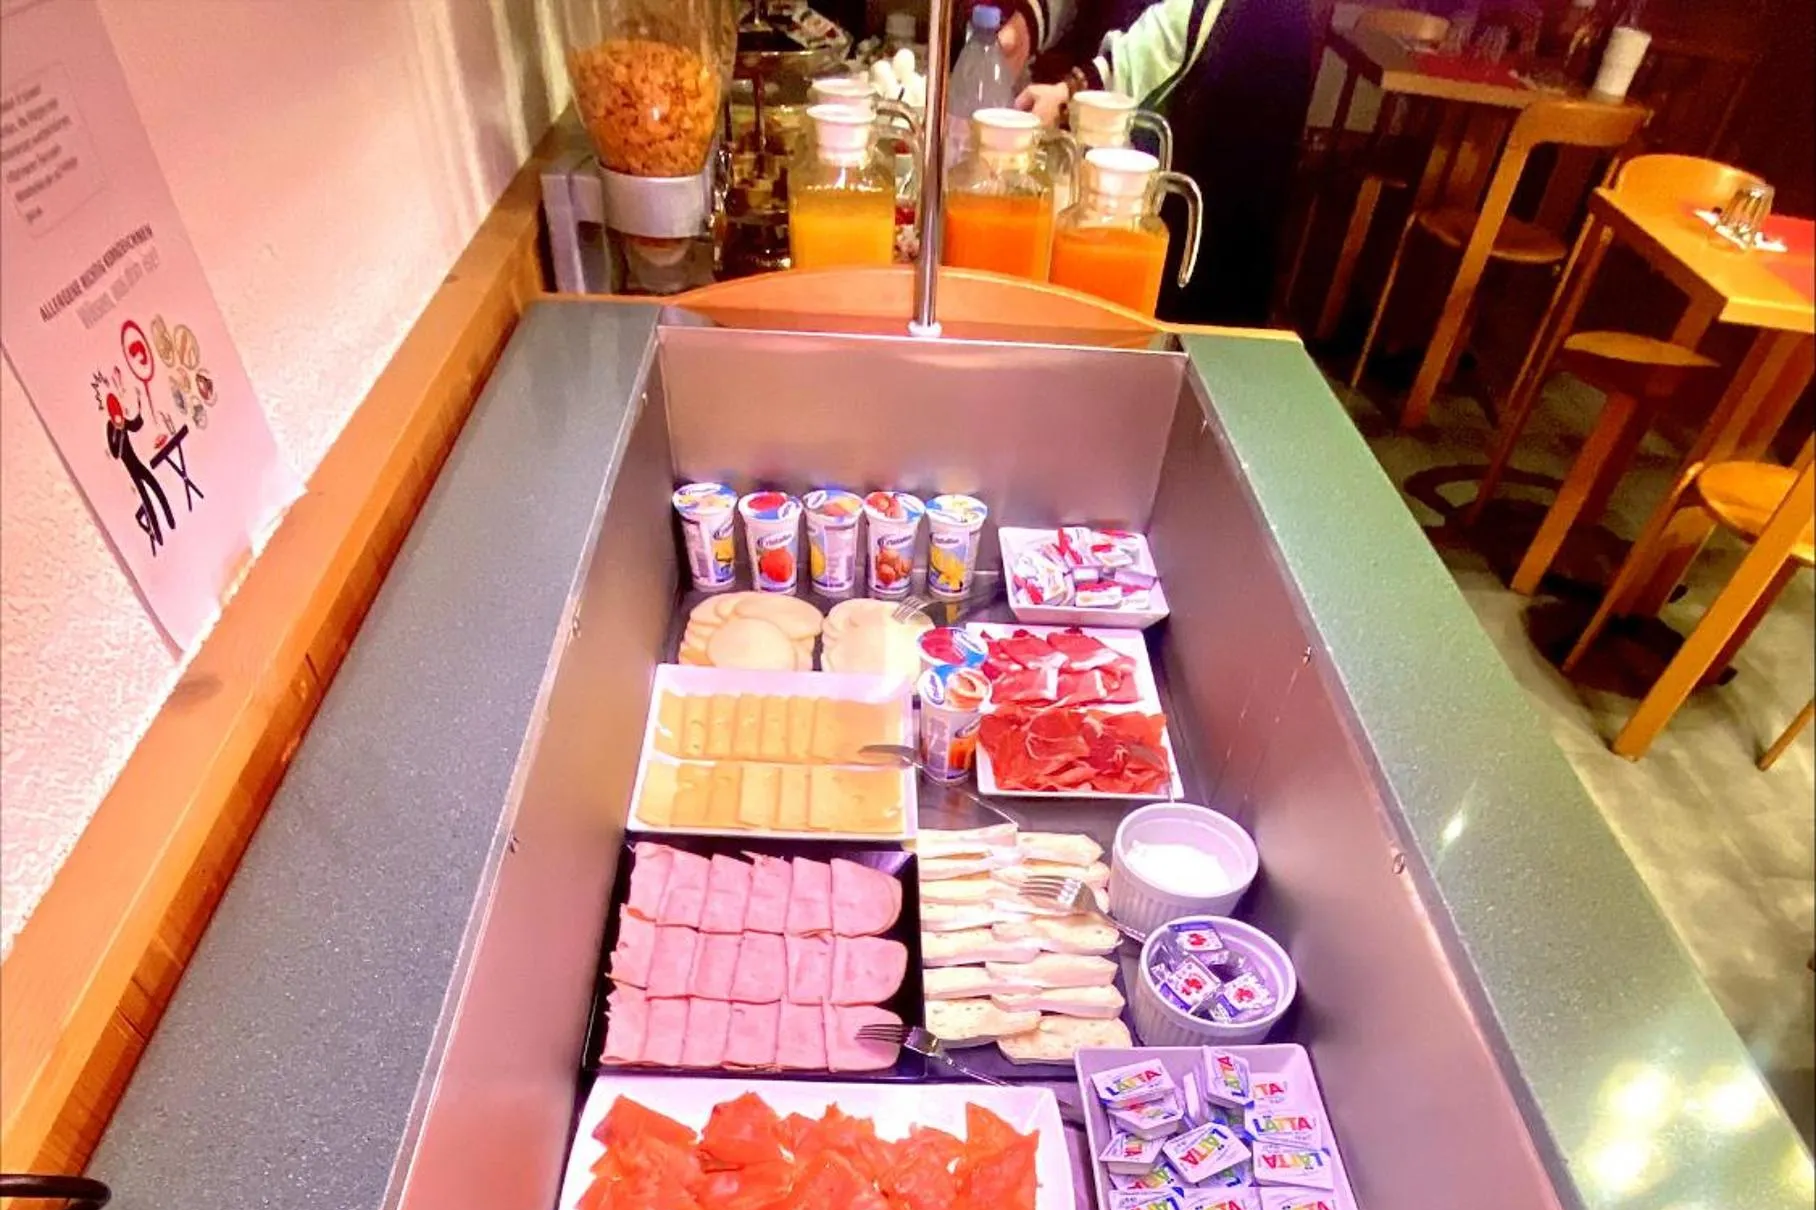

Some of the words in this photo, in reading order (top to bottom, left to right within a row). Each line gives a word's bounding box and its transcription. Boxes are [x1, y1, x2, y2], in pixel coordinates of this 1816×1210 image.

[1105, 1069, 1162, 1096] LÄTTA
[1253, 1115, 1312, 1133] LÄTTA
[1179, 1128, 1228, 1165] LÄTTA
[1262, 1152, 1323, 1170] LÄTTA
